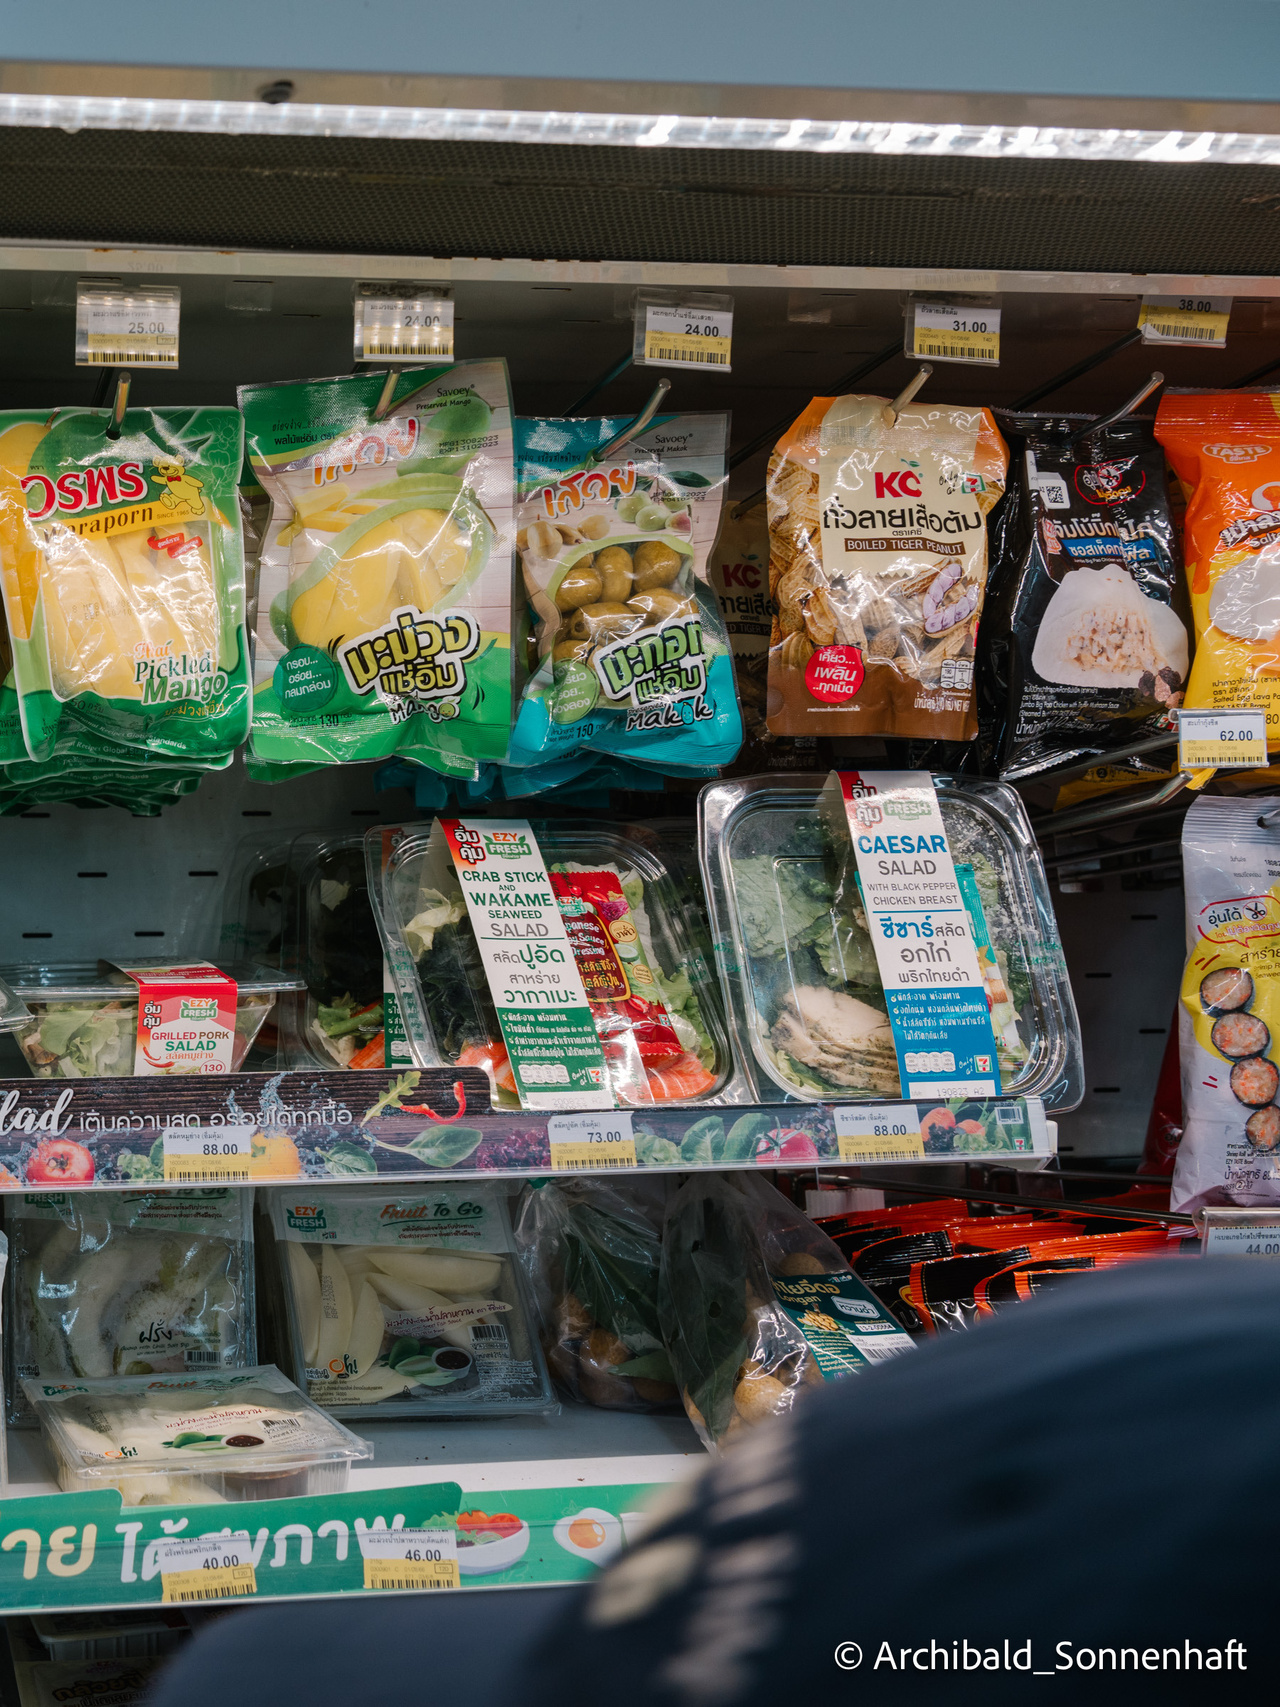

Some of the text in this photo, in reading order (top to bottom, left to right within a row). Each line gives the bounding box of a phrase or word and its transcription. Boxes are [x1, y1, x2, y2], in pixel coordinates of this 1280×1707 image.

[1178, 299, 1212, 313] 38.00
[128, 322, 165, 334] 25.00
[404, 315, 440, 328] 24.00
[952, 320, 987, 334] 31.00
[684, 323, 720, 338] 24.00
[436, 387, 471, 398] Savoey
[416, 398, 472, 411] Preserved Mango
[654, 434, 688, 446] Savoey
[1211, 446, 1266, 456] TASTE
[21, 462, 148, 520] วรพร
[542, 460, 636, 518] เสวย
[874, 469, 923, 499] KC
[823, 494, 982, 534] ถั่วลายเสือต้ม
[847, 539, 962, 555] BOILED TIGER PEANUT
[344, 612, 472, 690] มะม่วง
[135, 652, 212, 683] Pickled
[814, 665, 857, 682] เพลิน
[380, 660, 457, 695] แช่อิ่ม
[636, 664, 700, 702] แช่อิ่ม
[144, 672, 227, 706] Mango
[284, 678, 332, 700] กลมกล่อม
[319, 714, 339, 728] 130
[576, 724, 594, 738] 150
[1220, 730, 1254, 742] 62.00
[887, 802, 930, 815] FRESH
[455, 826, 479, 844] อิ่ม
[492, 832, 518, 842] EZY
[490, 844, 529, 854] FRESH
[858, 835, 948, 854] CAESAR
[460, 846, 484, 863] คุ้ม
[878, 860, 937, 876] SALAD
[462, 870, 546, 882] CRAB STICK
[498, 884, 516, 892] AND
[867, 882, 957, 892] WITH BLACK PEPPER
[470, 892, 554, 907] WAKAME
[872, 896, 958, 906] CHICKEN BREAST
[488, 910, 542, 919] SEAWEED
[1208, 907, 1243, 928] อุ่นได้
[490, 922, 549, 938] SALAD
[880, 916, 966, 939] ซีซาร์สลัด
[492, 943, 566, 970] สลัดปูอัด
[900, 940, 952, 964] อกไก่
[509, 970, 561, 984] สาหร่าย
[898, 966, 970, 984] พริกไทยดำ
[504, 988, 578, 1004] วากาเมะ
[143, 1001, 162, 1015] อิ่ม
[190, 999, 212, 1008] EZY
[183, 1008, 214, 1018] FRESH
[142, 1014, 162, 1029] คุ้ม
[152, 1030, 230, 1040] GRILLED PORK
[164, 1040, 216, 1052] SALAD
[204, 1064, 223, 1072] 130
[210, 1098, 353, 1132] อร่อยได้ทุกมื้อ
[587, 1130, 621, 1144] 73.00
[874, 1124, 908, 1137] 88.00
[203, 1144, 238, 1156] 88.00
[294, 1206, 317, 1216] EZY
[380, 1202, 484, 1220] Fruit To Go
[290, 1218, 324, 1228] FRESH
[1246, 1243, 1280, 1256] 44.00
[328, 1354, 358, 1376] Oh!
[202, 1554, 239, 1570] 40.00
[405, 1549, 442, 1562] 46.00
